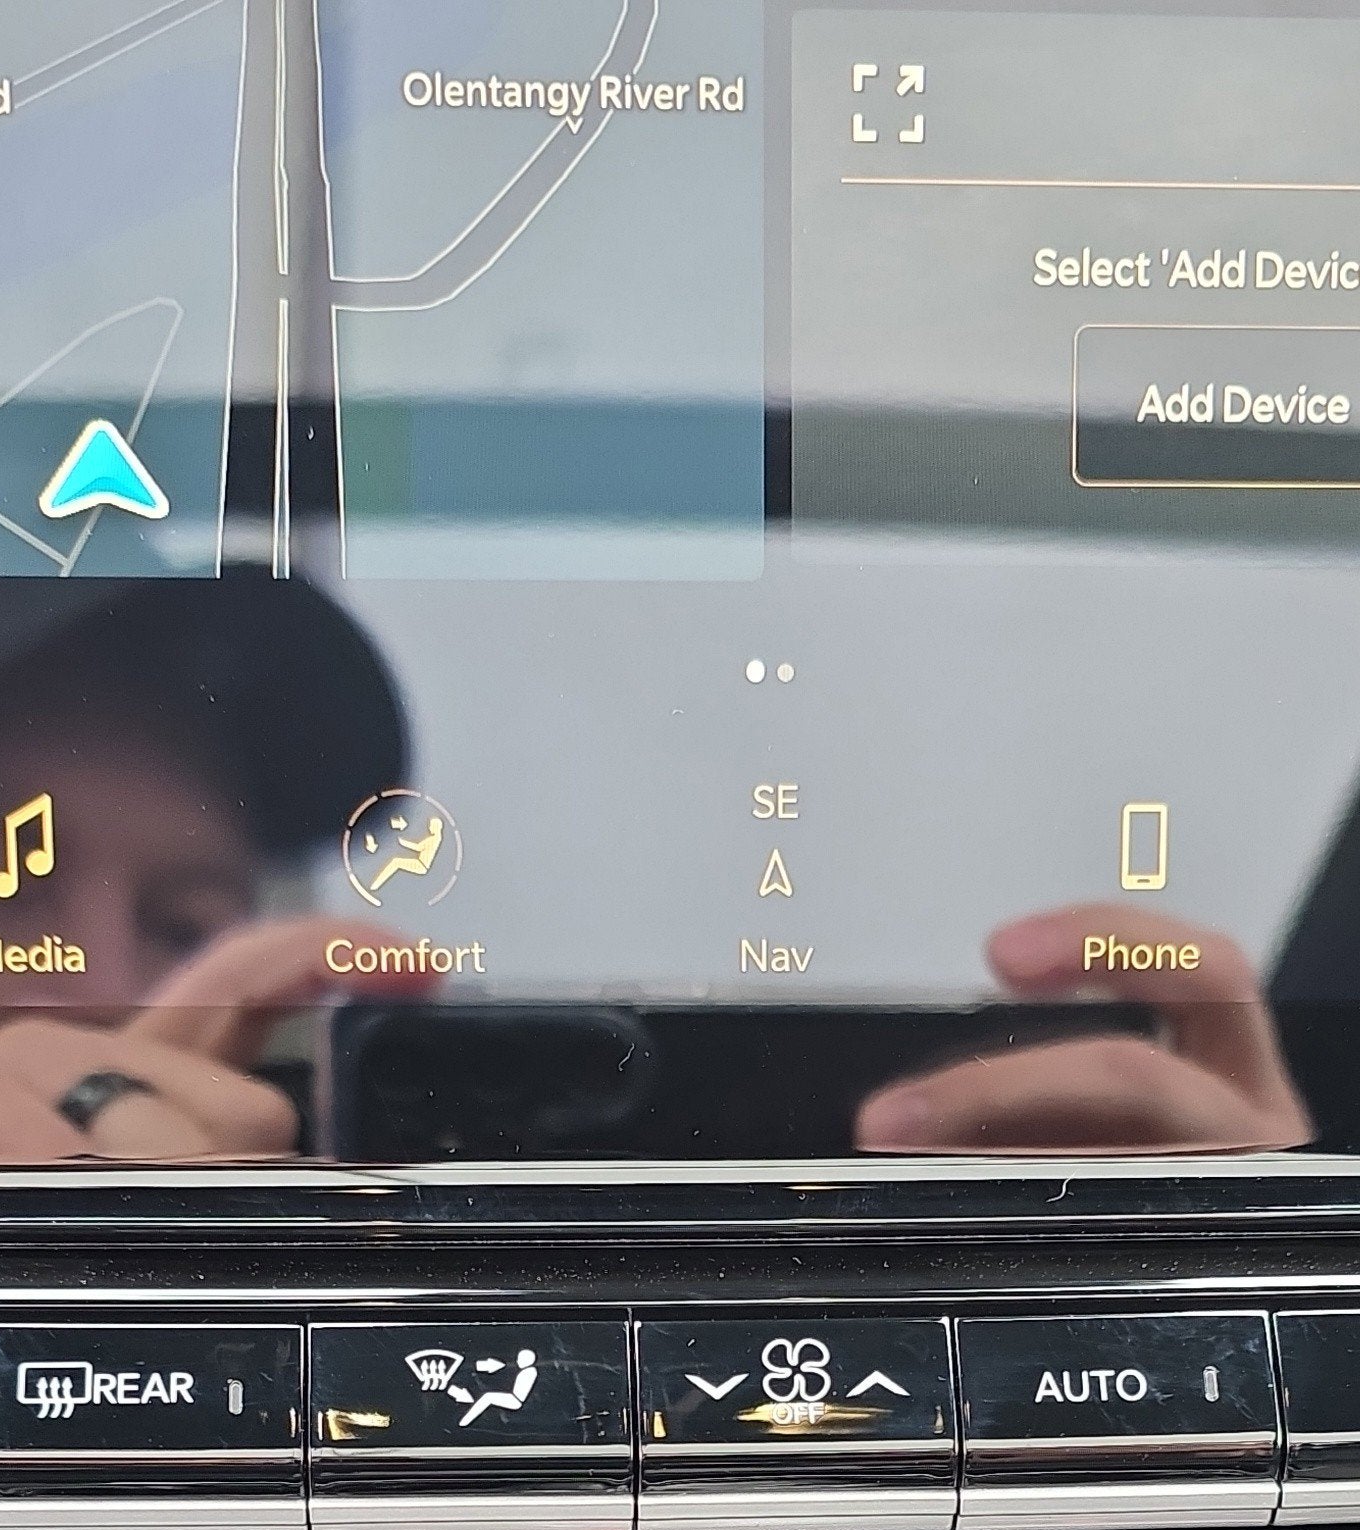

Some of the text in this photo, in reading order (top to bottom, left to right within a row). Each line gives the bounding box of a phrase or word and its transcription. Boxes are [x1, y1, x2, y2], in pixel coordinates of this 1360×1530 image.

[402, 71, 744, 117] Olentangy River Rd
[1033, 247, 1151, 288] Select
[1161, 248, 1246, 289] 'Add
[1137, 383, 1351, 425] Add Device
[752, 784, 799, 820] SE
[325, 937, 486, 974] Comfort
[740, 939, 813, 973] Nav
[1082, 934, 1201, 971] Phone
[92, 1372, 195, 1406] REAR
[1034, 1369, 1148, 1403] AUTO
[772, 1401, 827, 1426] OFF
